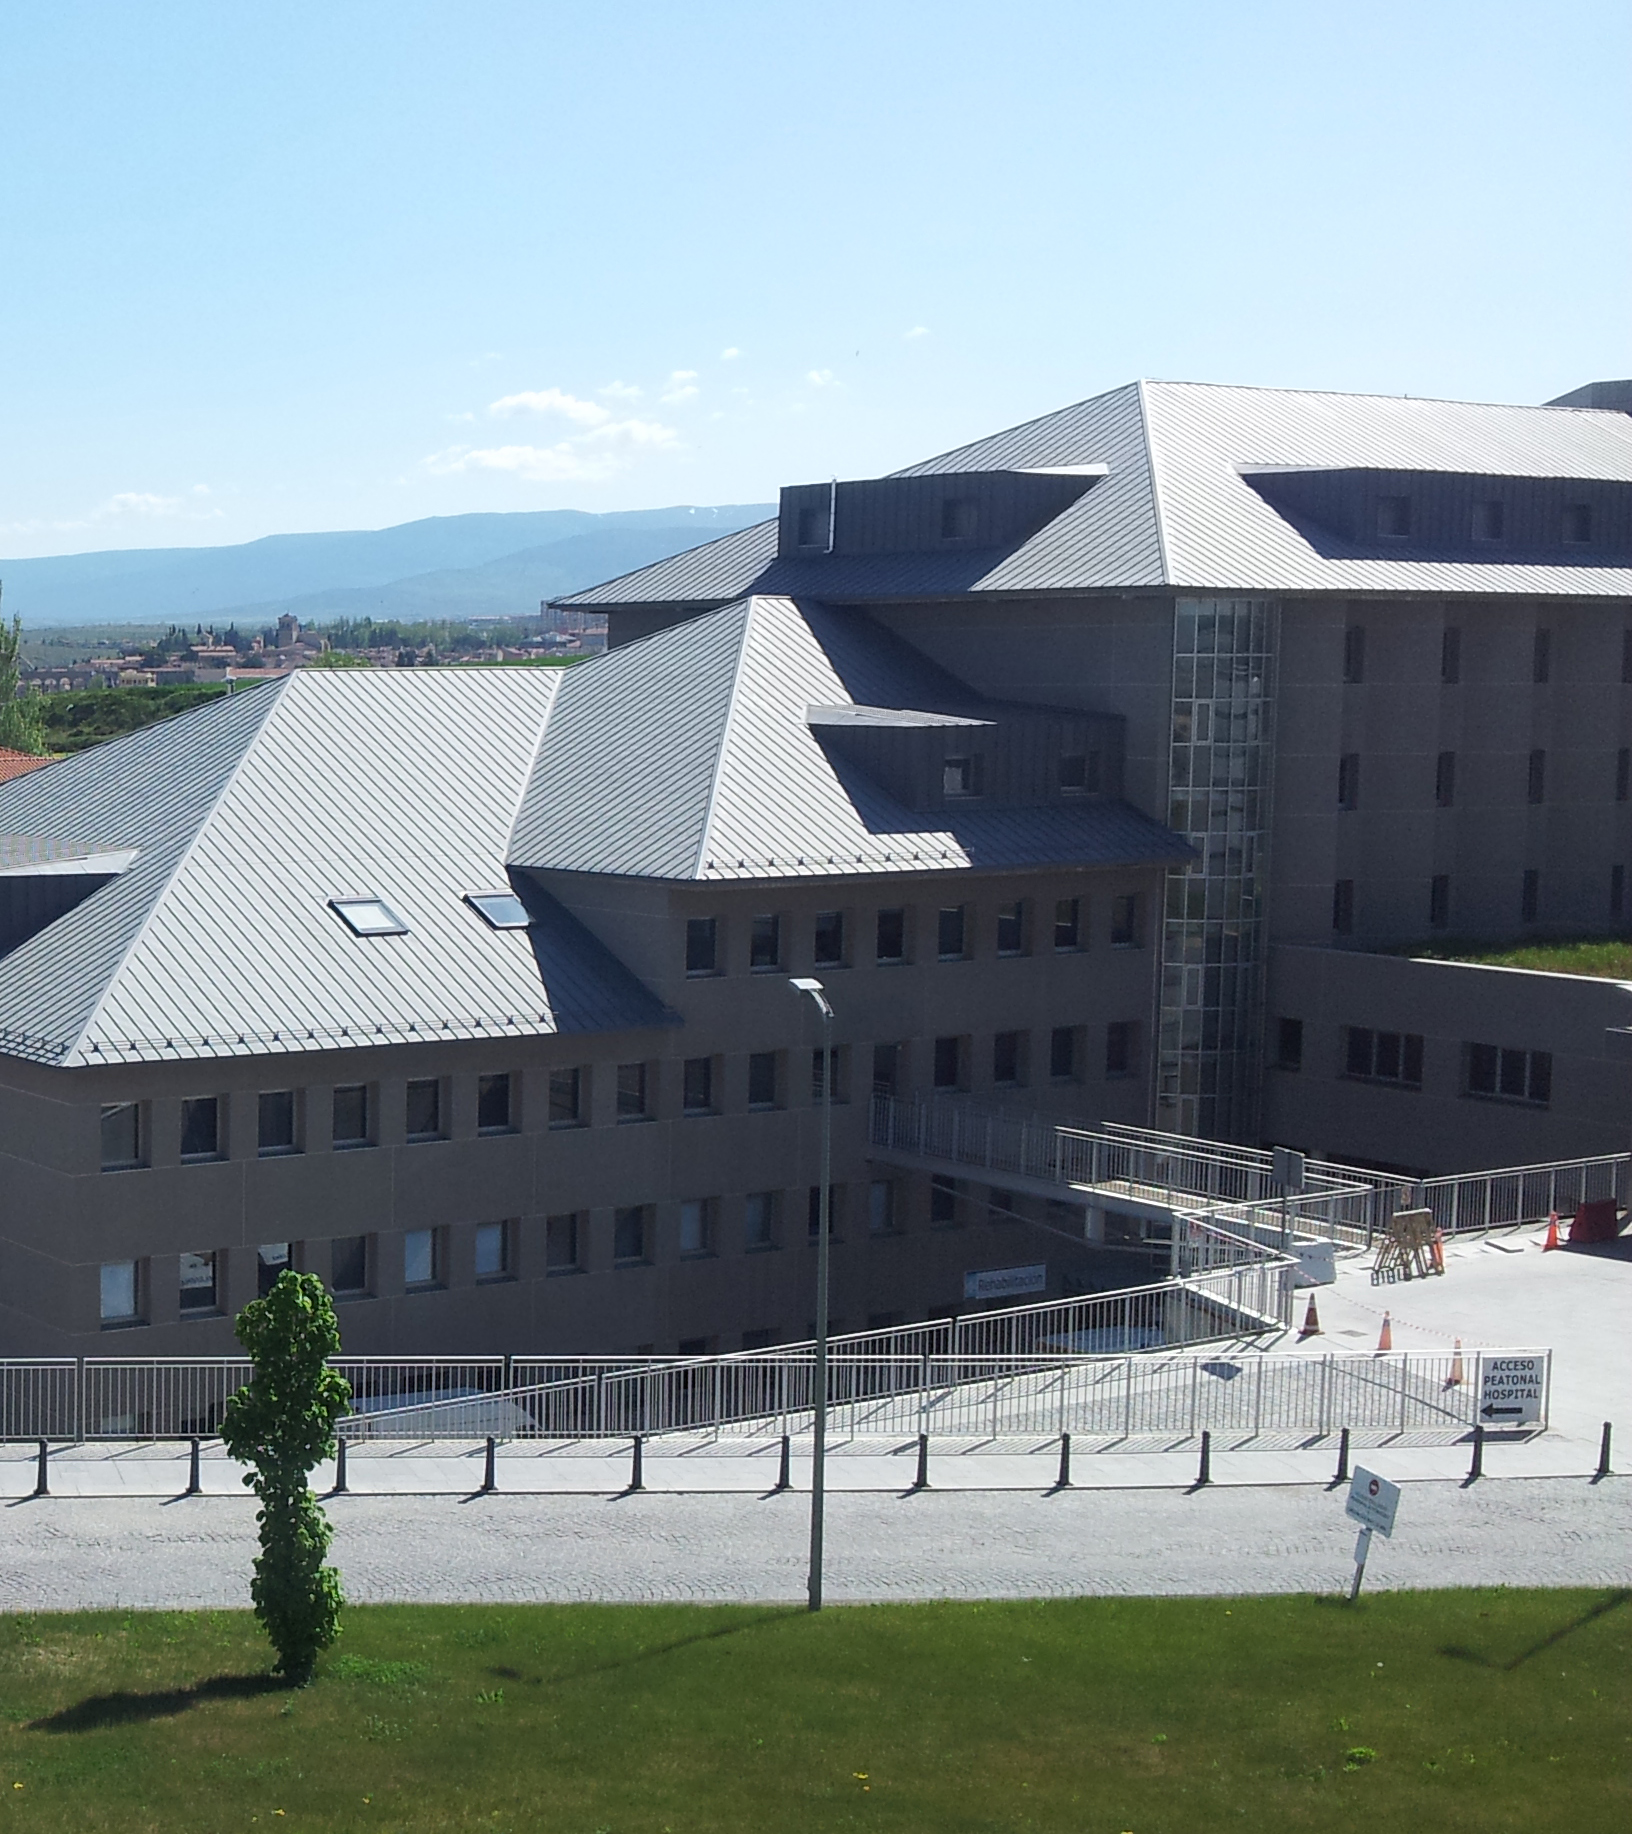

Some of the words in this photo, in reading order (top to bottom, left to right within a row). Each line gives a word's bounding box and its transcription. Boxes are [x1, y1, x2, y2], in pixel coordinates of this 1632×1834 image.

[1492, 1360, 1535, 1371] ACCESO
[1483, 1374, 1541, 1386] PEATONAL
[1483, 1388, 1539, 1400] HOSPITAL
